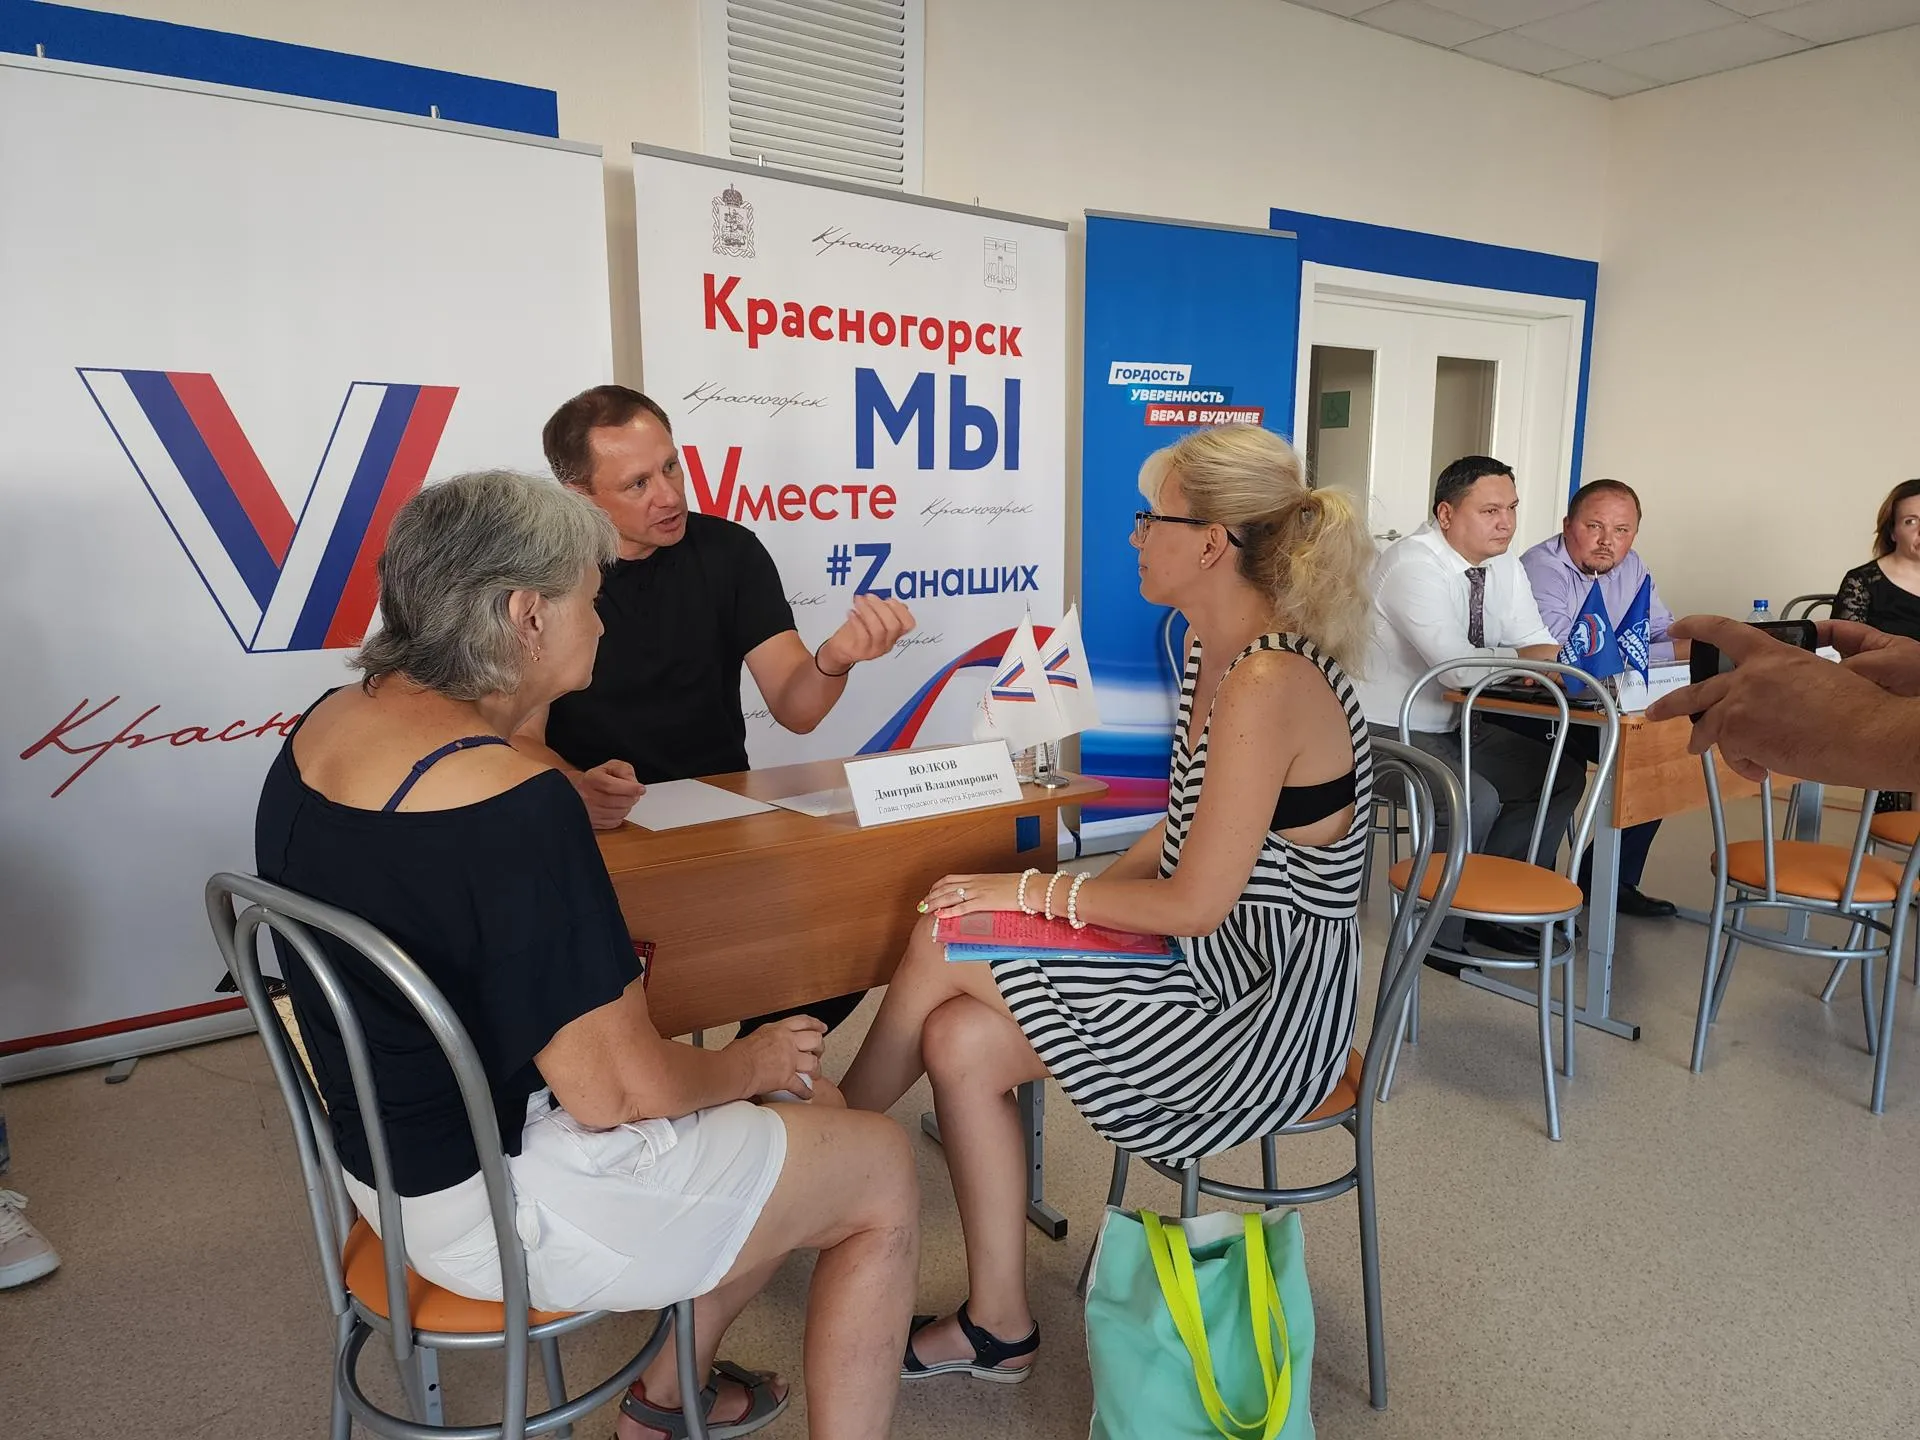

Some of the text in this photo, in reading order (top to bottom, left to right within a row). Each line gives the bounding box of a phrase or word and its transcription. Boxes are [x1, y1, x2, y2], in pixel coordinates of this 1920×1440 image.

[812, 225, 943, 266] Красногорск
[703, 273, 1022, 365] Красногорск
[1115, 368, 1185, 382] ГОРДОСТЬ
[682, 381, 830, 418] Красногорск
[1130, 388, 1224, 403] УВЕРЕННОСТЬ
[855, 367, 1021, 470] МЫ
[1150, 409, 1260, 425] ВЕРА В БУДУЩЕЕ
[682, 445, 897, 521] Vместе
[919, 497, 1035, 526] Красногорск
[826, 543, 1039, 601] #Zанаших
[908, 760, 958, 776] ВОЛКОВ
[874, 772, 999, 801] Дмитрий Владимирович
[878, 805, 899, 814] Глава
[900, 798, 938, 811] городского
[939, 794, 961, 805] округа
